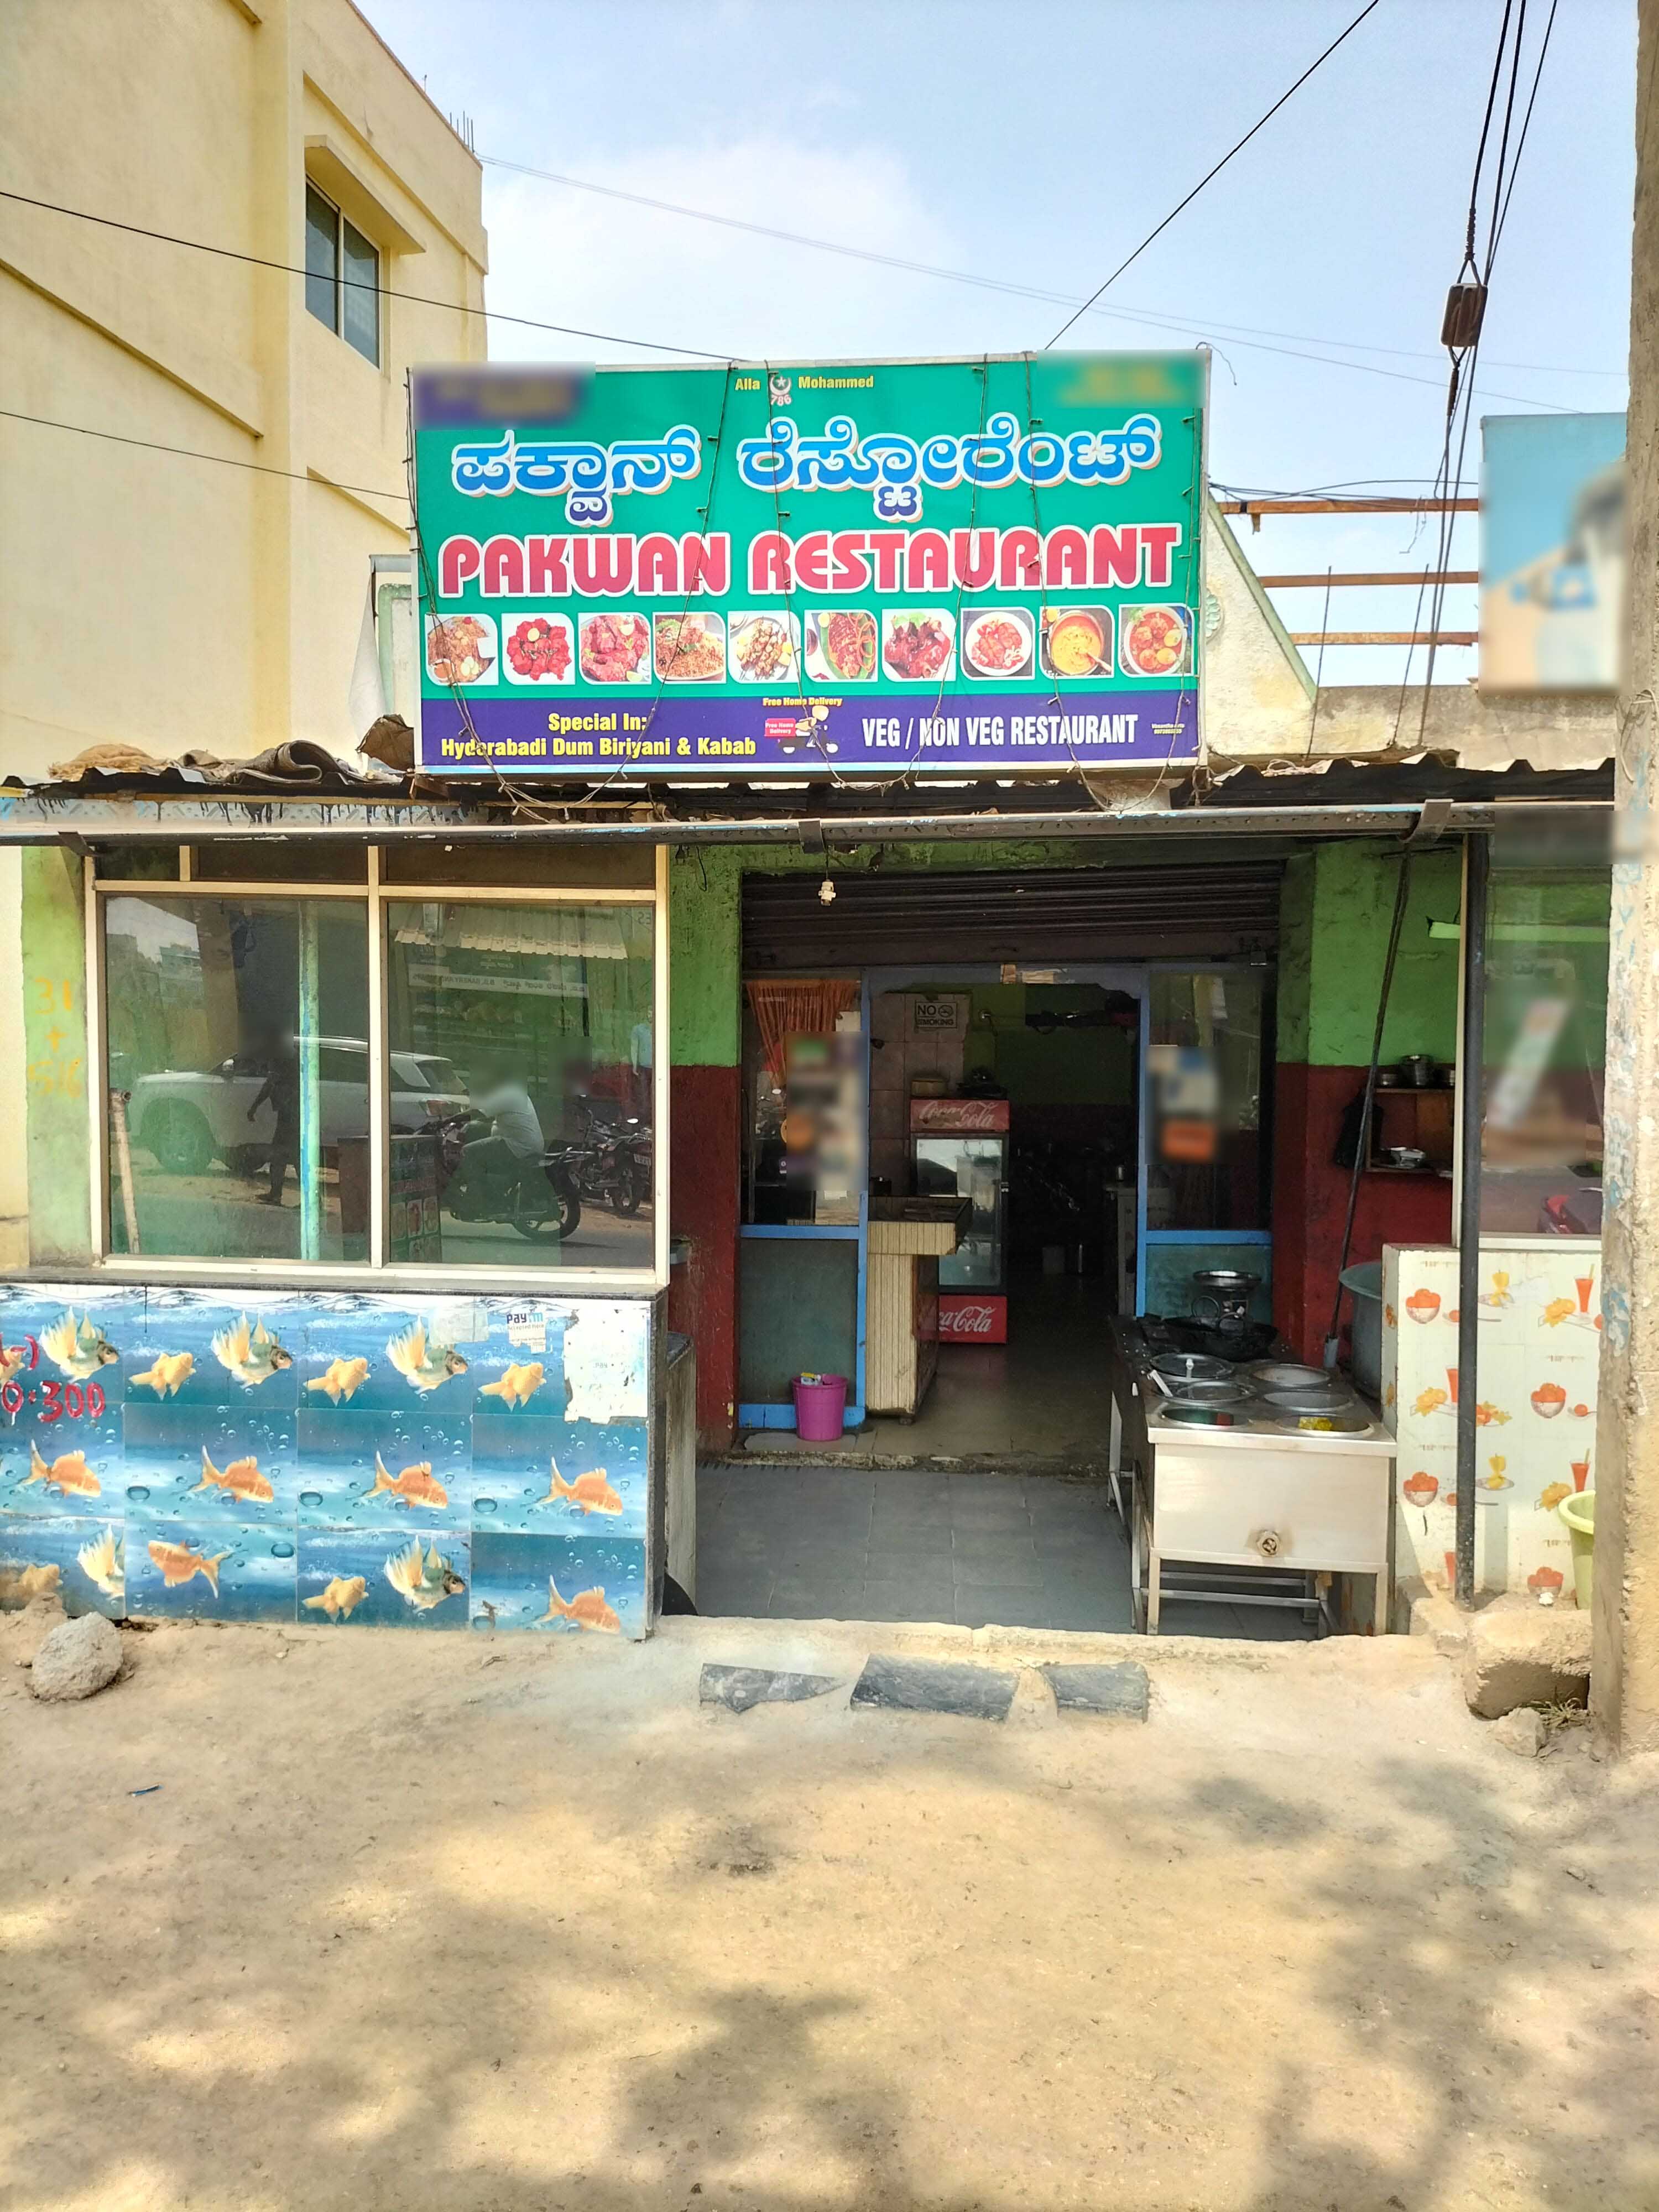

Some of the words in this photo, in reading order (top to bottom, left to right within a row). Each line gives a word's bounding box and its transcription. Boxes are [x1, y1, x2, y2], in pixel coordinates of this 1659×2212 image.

[734, 378, 761, 390] Alla
[798, 376, 874, 389] Mohammed
[770, 394, 792, 406] 786
[440, 533, 729, 596] PAKWAN
[749, 524, 1181, 594] RESTAURANT
[762, 697, 782, 706] Free
[783, 697, 807, 706] Home
[808, 697, 843, 707] Delivery
[548, 713, 617, 734] Special
[623, 713, 648, 731] In:
[862, 718, 901, 747] VEG
[919, 717, 960, 747] NON
[965, 717, 1005, 747] VEG
[1010, 714, 1139, 746] RESTAURANT
[441, 738, 547, 760] Hyderabadi
[552, 737, 593, 756] Dum
[599, 737, 670, 759] Biriyani
[676, 737, 691, 755] &
[697, 737, 756, 755] Kabab
[917, 1005, 936, 1015] NO
